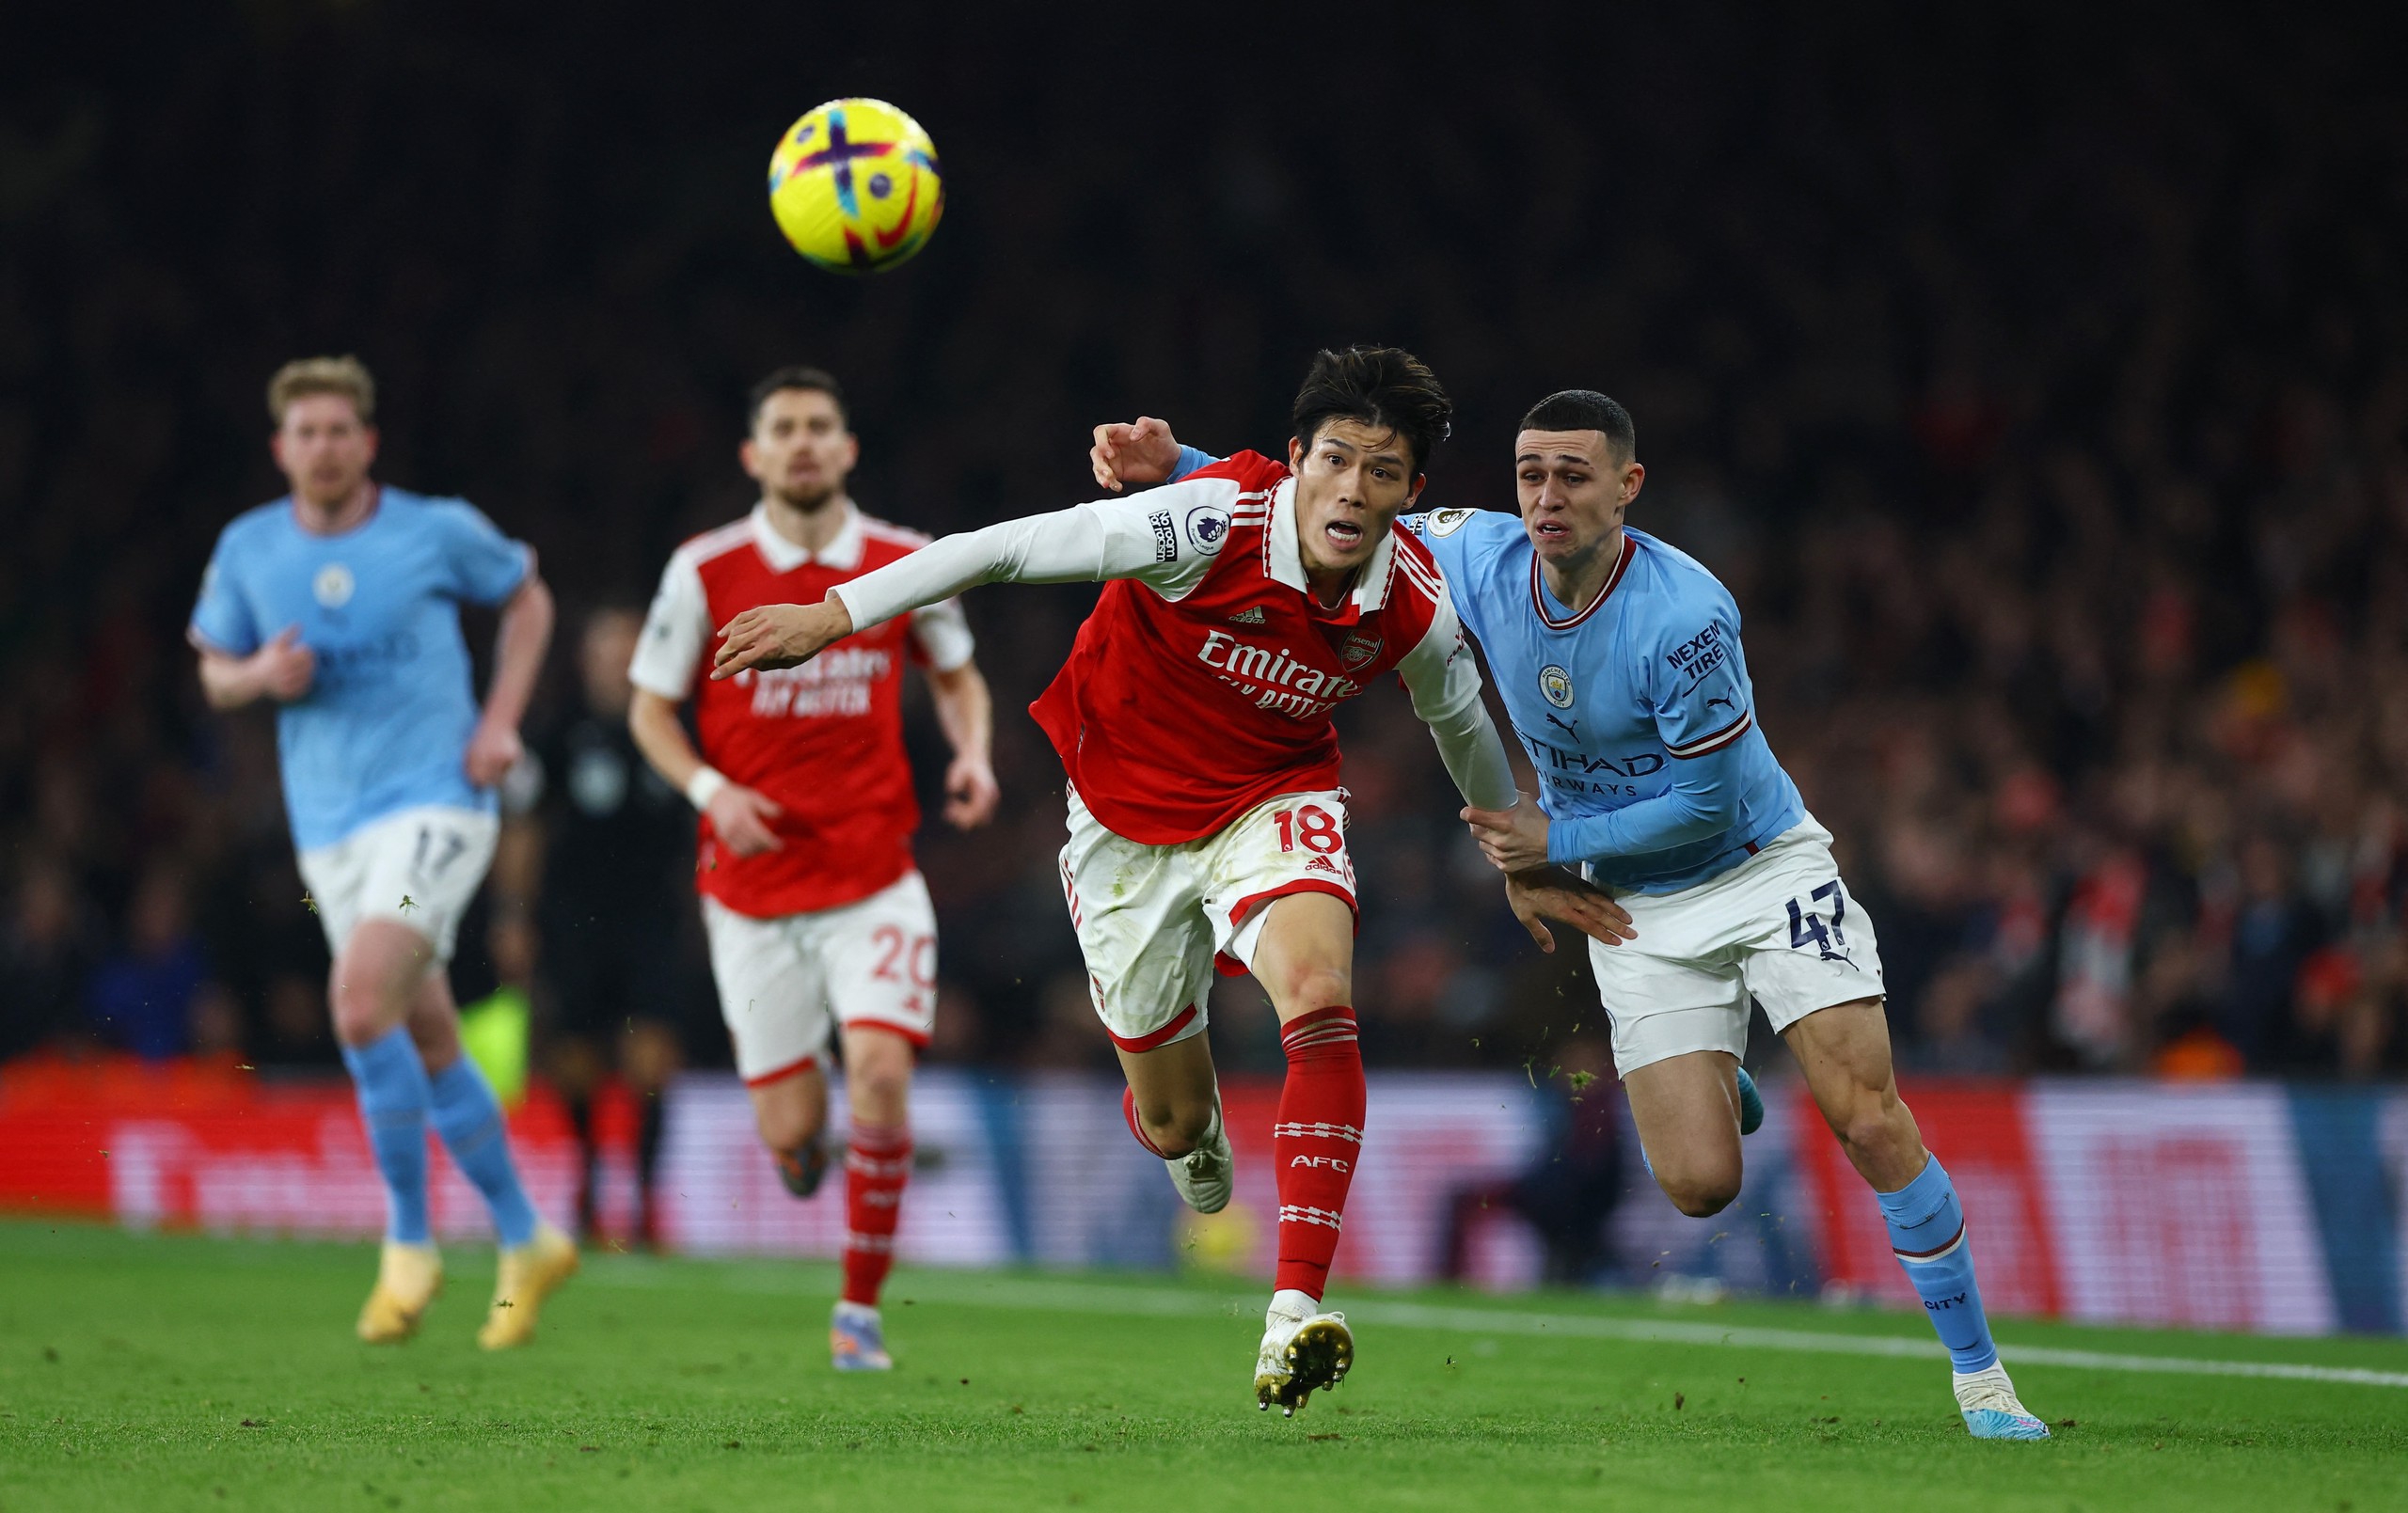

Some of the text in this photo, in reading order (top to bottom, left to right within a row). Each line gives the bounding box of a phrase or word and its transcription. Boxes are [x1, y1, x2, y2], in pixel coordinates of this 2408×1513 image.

[1149, 512, 1166, 562] for racism
[1157, 510, 1175, 558] No room
[1190, 528, 1214, 551] Premier League
[1228, 615, 1266, 624] adidas
[1350, 635, 1378, 649] Arsenal
[1666, 619, 1720, 670] NEXEN
[1197, 629, 1363, 699] Emirate
[1683, 643, 1723, 680] TIRE
[1542, 668, 1571, 686] MANCHESTER
[1273, 804, 1343, 855] 18
[1305, 862, 1343, 875] adidas
[1784, 879, 1846, 952] 47
[1291, 1155, 1349, 1174] AFC
[1924, 1292, 1966, 1311] CITY
